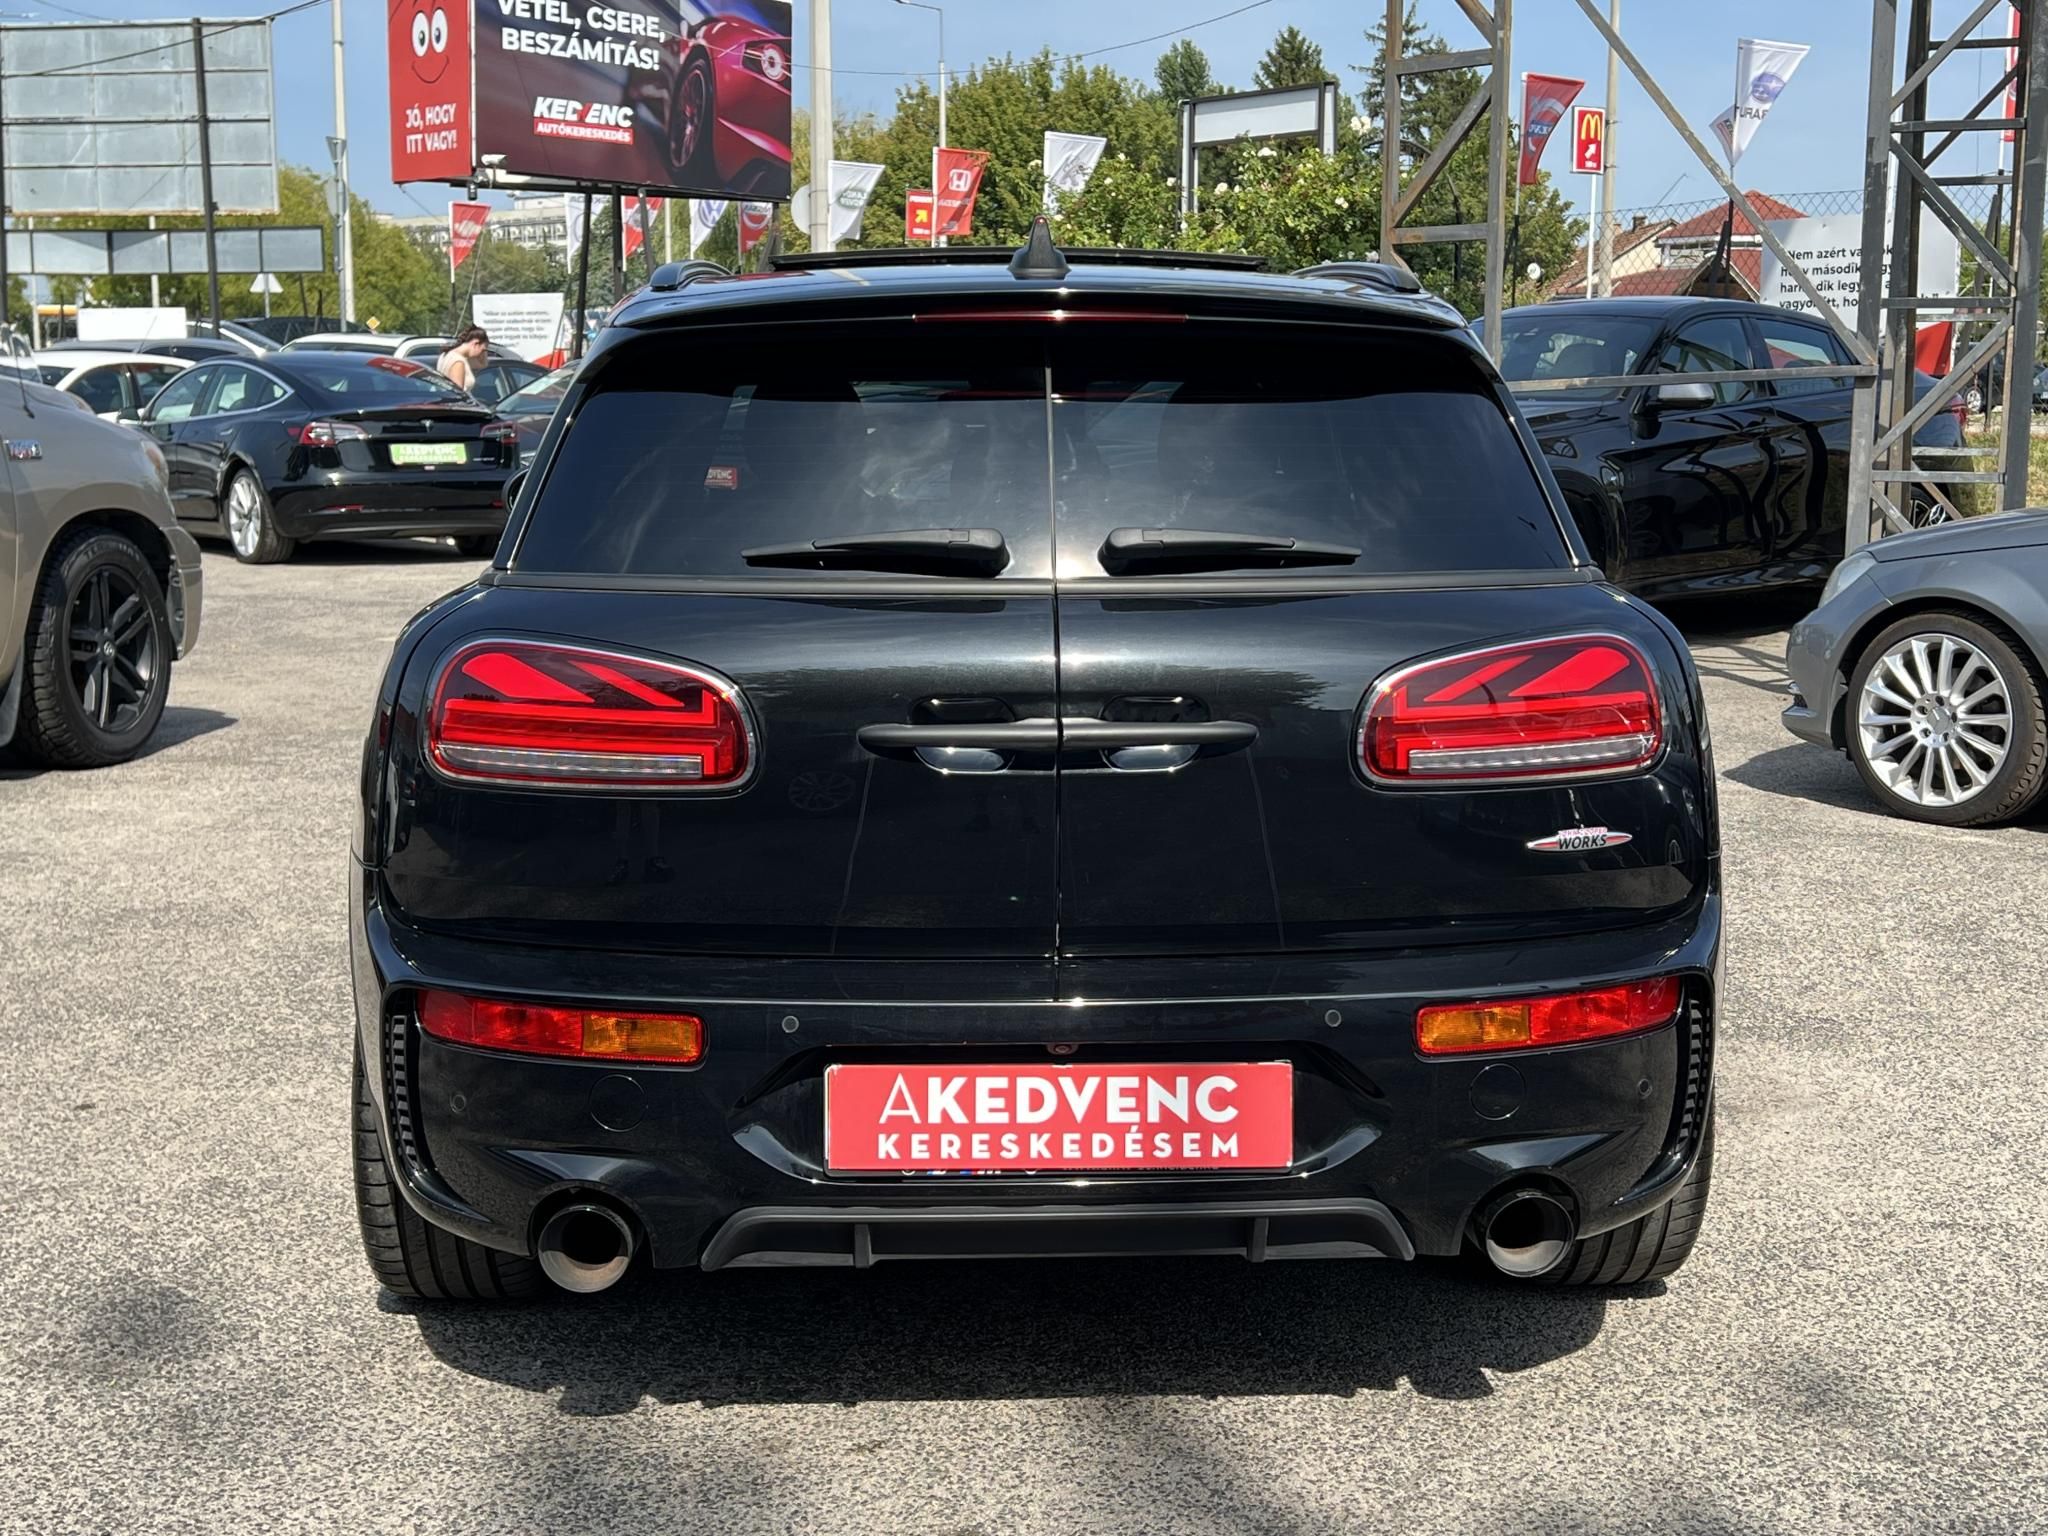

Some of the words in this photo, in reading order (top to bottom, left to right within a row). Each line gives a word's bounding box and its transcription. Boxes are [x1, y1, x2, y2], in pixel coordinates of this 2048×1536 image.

[586, 6, 667, 43] CSERE,
[501, 27, 661, 71] BESZÁMÍTÁS!
[405, 103, 424, 131] JÓ,
[425, 102, 457, 126] HOGY
[406, 133, 424, 154] ITT
[424, 129, 458, 152] VAGY!
[536, 122, 631, 143] AUTÓKERESKEDÉS
[1816, 246, 1846, 259] azért
[1812, 262, 1861, 276] második
[1780, 279, 1834, 293] hardik
[1779, 299, 1816, 311] vagyo
[1558, 834, 1608, 850] WORKS
[877, 1126, 1240, 1160] KERESKEDÉSEM
